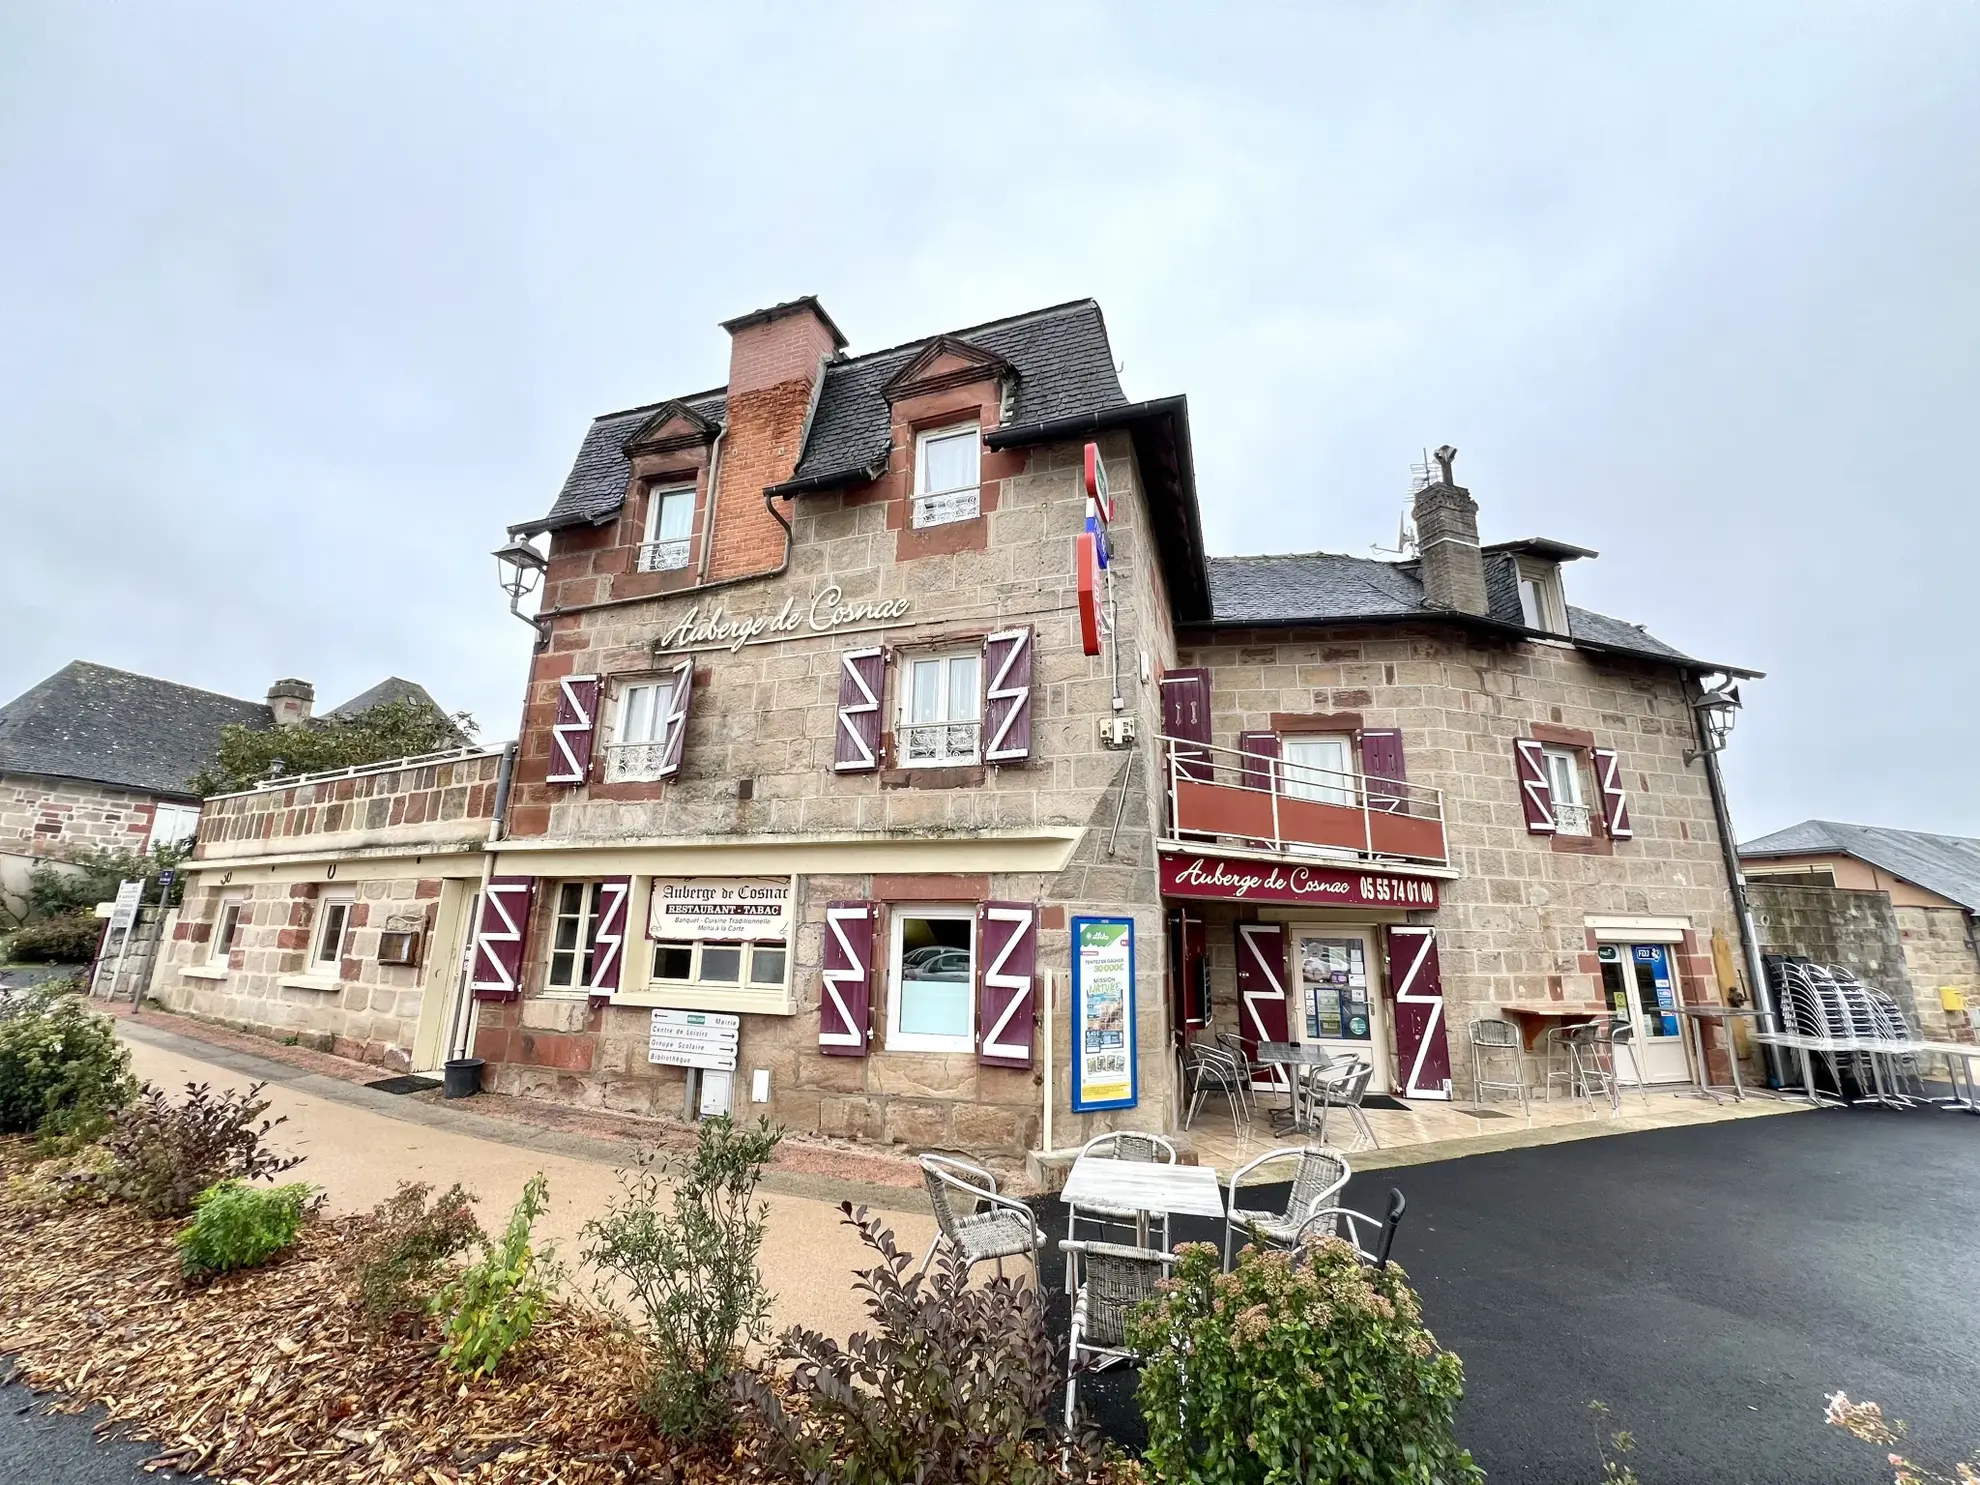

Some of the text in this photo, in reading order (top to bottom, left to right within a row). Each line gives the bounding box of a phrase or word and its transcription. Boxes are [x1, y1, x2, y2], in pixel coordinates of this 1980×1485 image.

[660, 585, 911, 653] Auberge de Cosnac
[1175, 859, 1433, 904] Auberge de Cosnac 05 55 74 01 00
[662, 884, 717, 902] Auberge
[721, 887, 734, 899] de
[668, 904, 736, 915] RESTAURANT
[743, 905, 779, 915] TABAC
[1638, 949, 1650, 957] FDJ
[715, 1018, 737, 1026] Mairie
[652, 1026, 708, 1037] Centre de Loisirs
[651, 1039, 705, 1050] Groupe Scolaire
[650, 1053, 691, 1064] Bibliothèque
